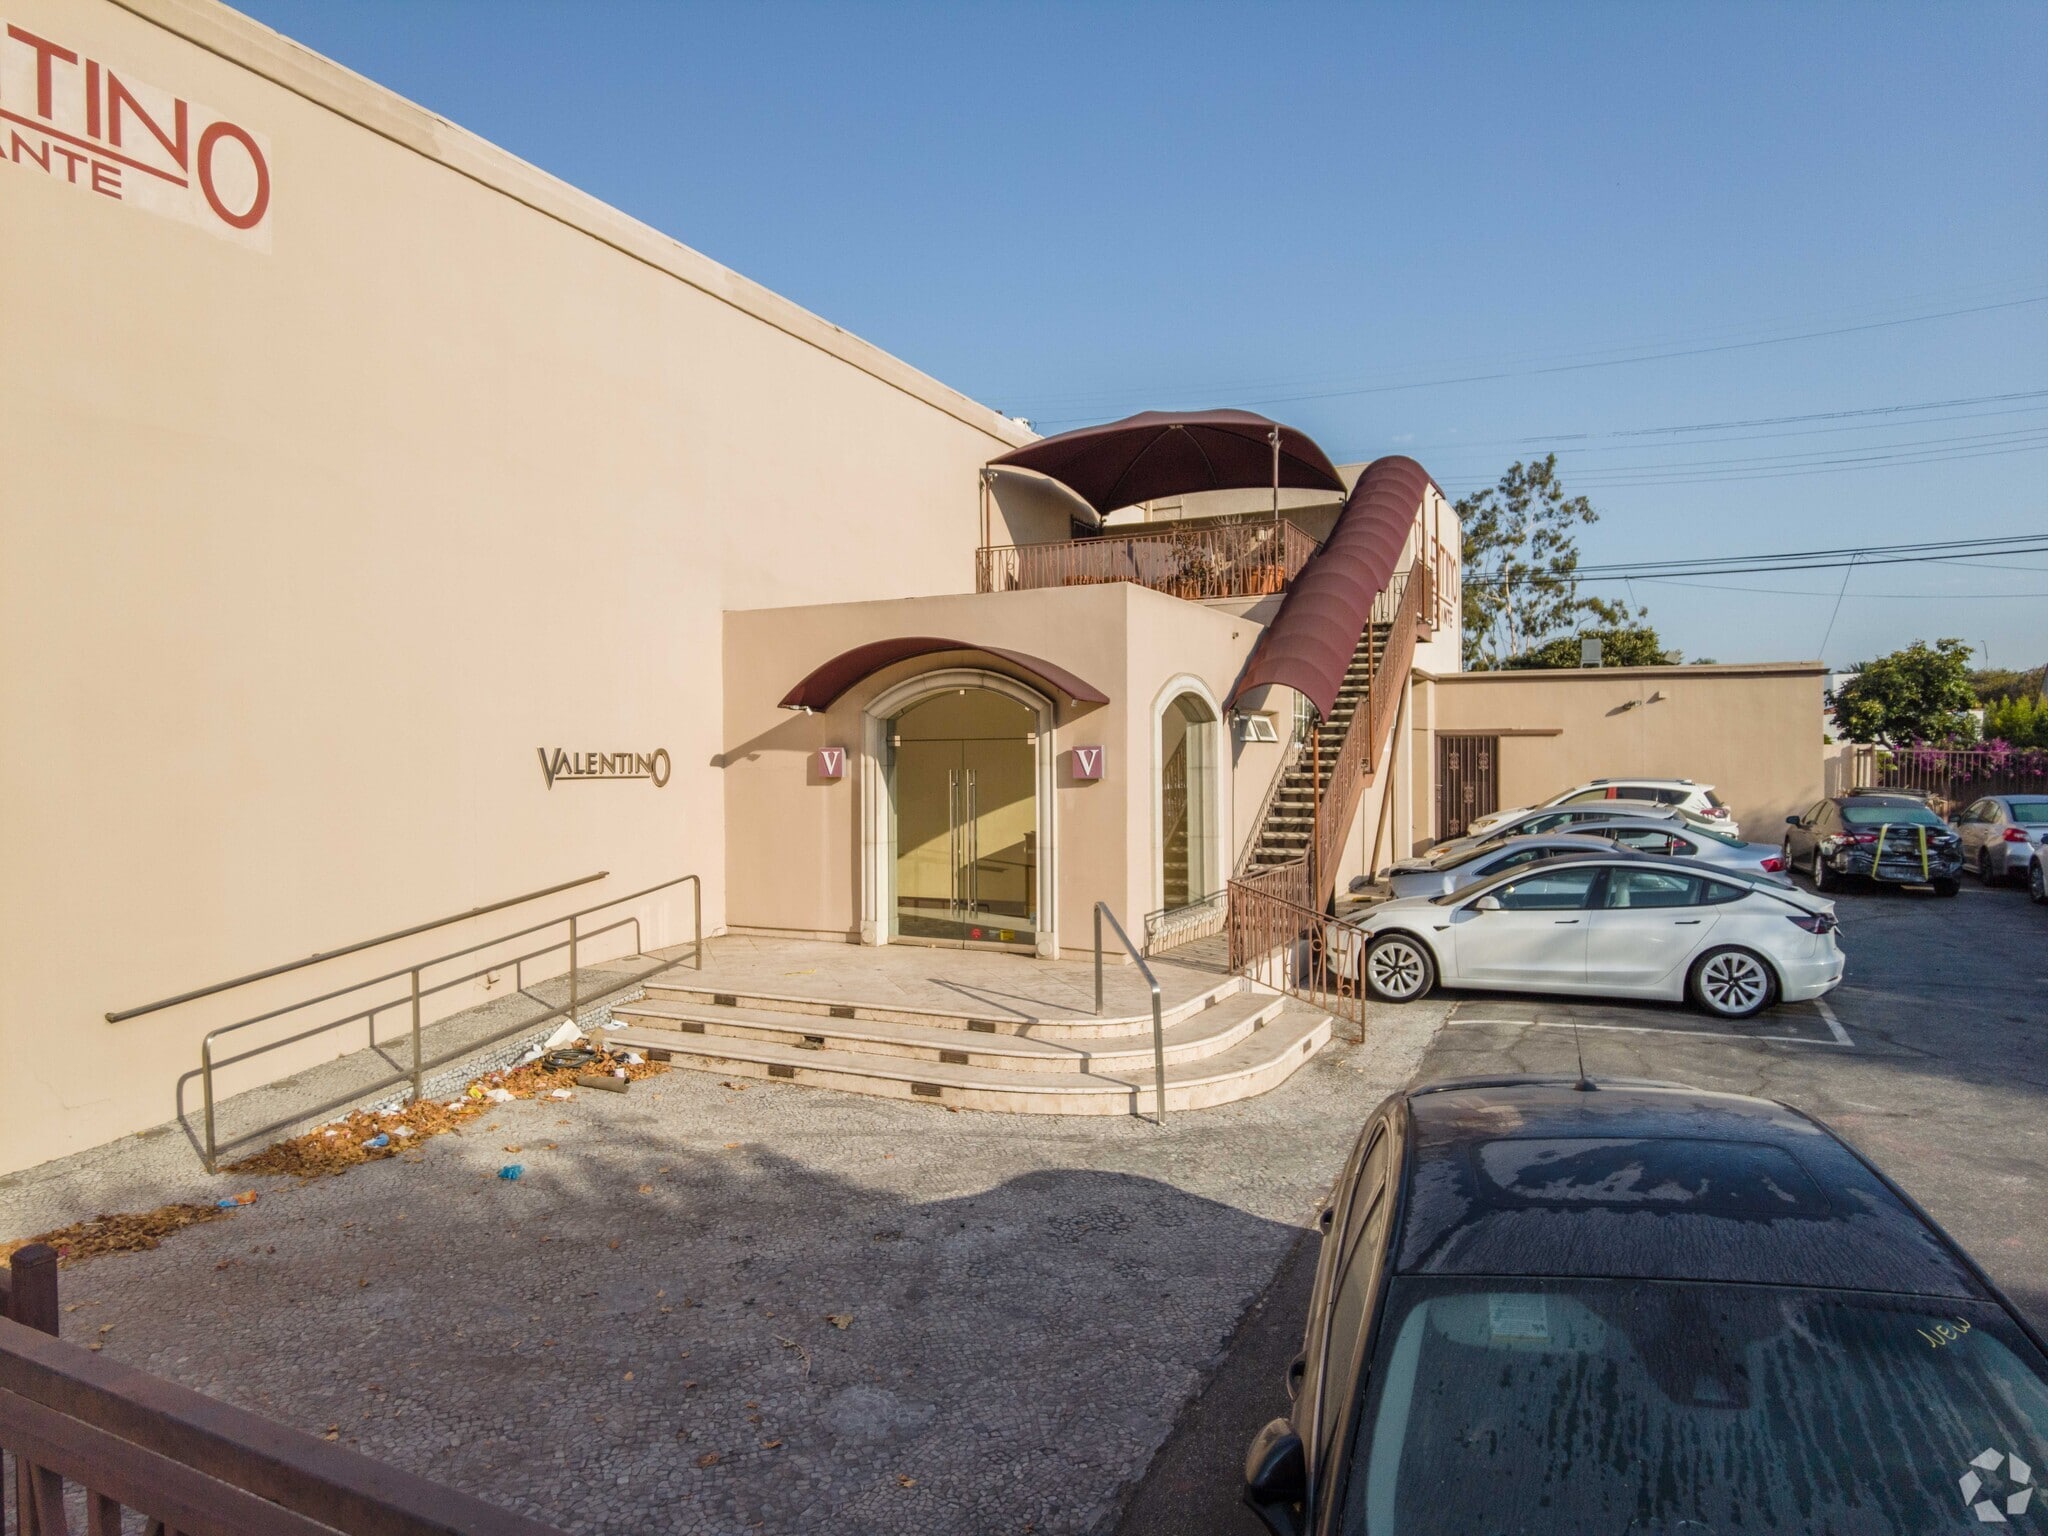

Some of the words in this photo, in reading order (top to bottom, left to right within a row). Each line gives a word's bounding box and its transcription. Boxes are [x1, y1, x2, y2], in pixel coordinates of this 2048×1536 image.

[820, 751, 840, 776] V
[1074, 749, 1100, 776] V
[1916, 1315, 1971, 1348] NEW
